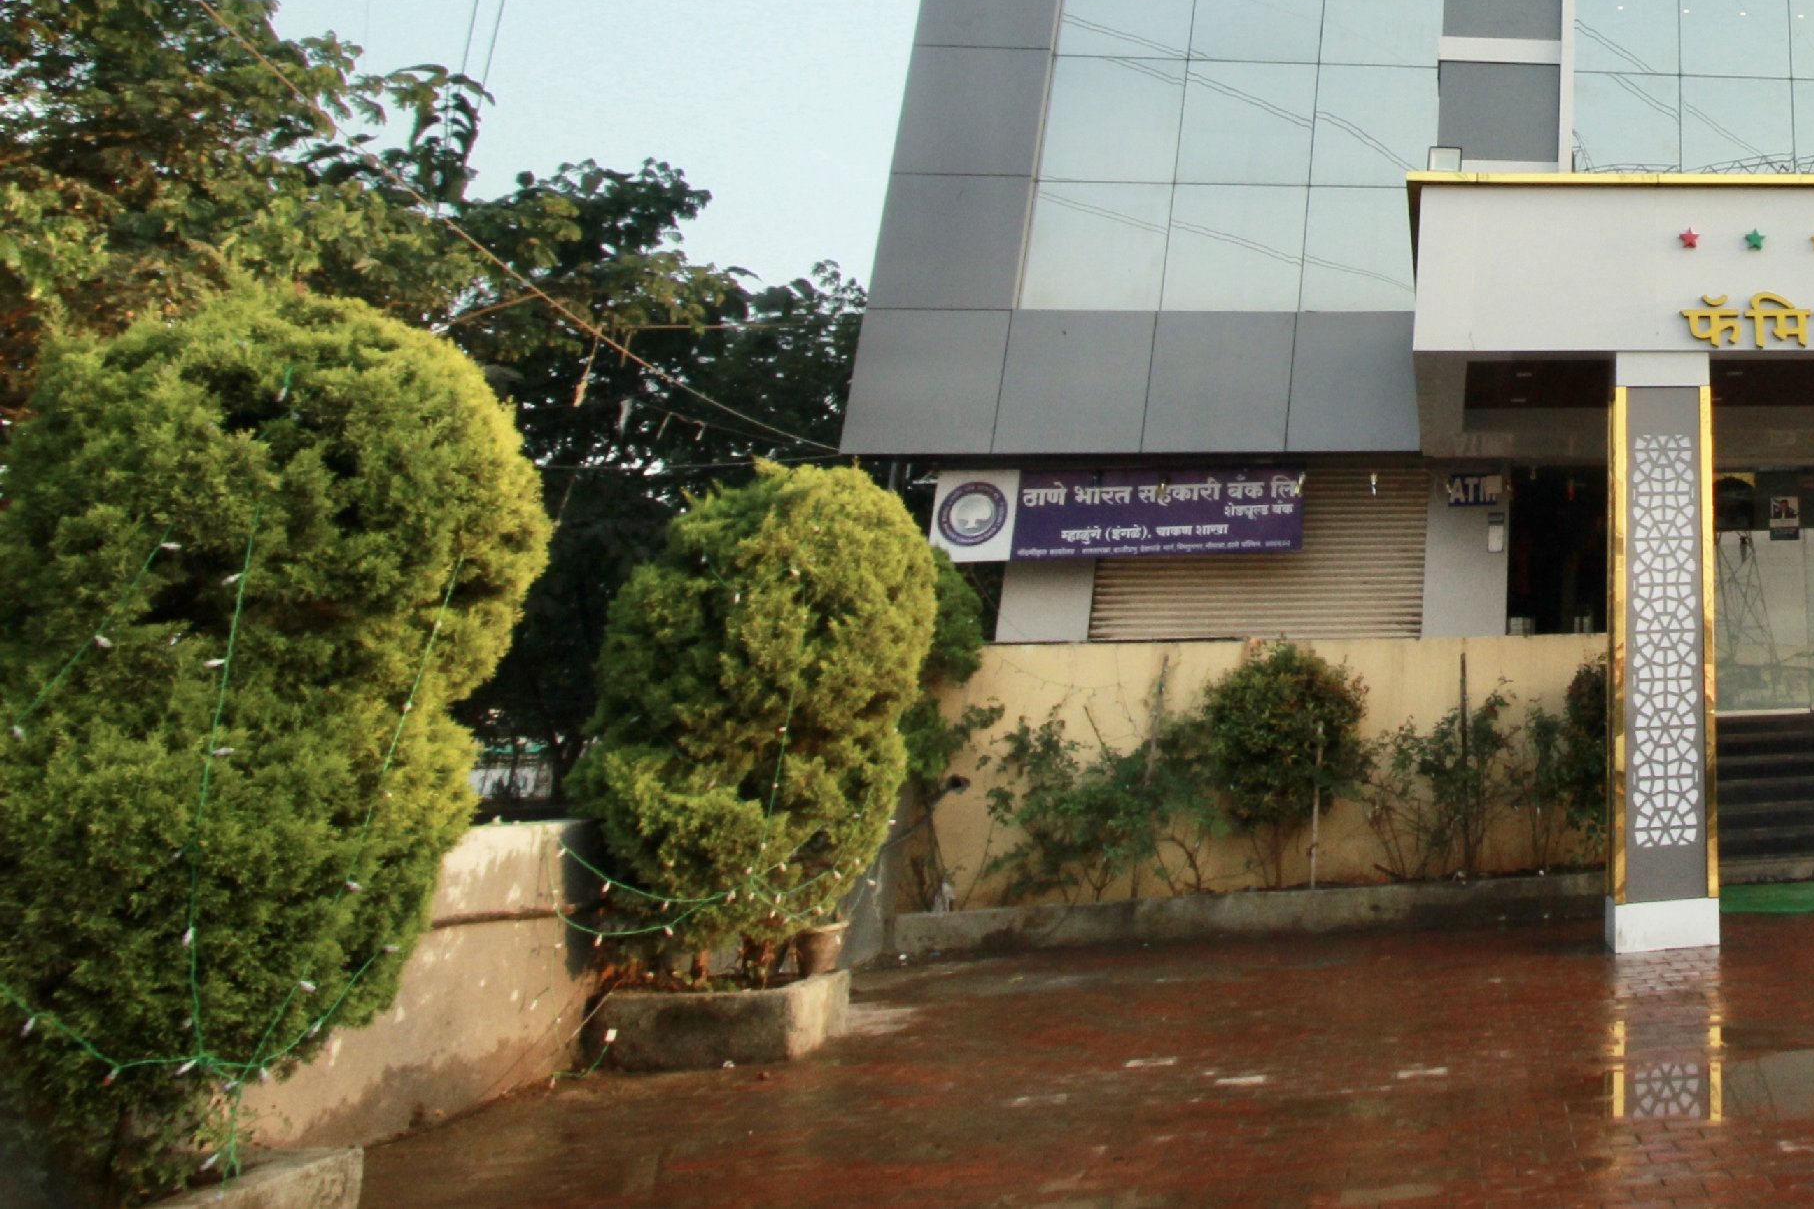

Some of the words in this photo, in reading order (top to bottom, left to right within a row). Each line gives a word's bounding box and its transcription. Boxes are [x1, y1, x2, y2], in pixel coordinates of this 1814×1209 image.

[1023, 481, 1067, 507] ठाणे
[1074, 485, 1133, 505] भारत
[1137, 477, 1223, 506] सहकारी
